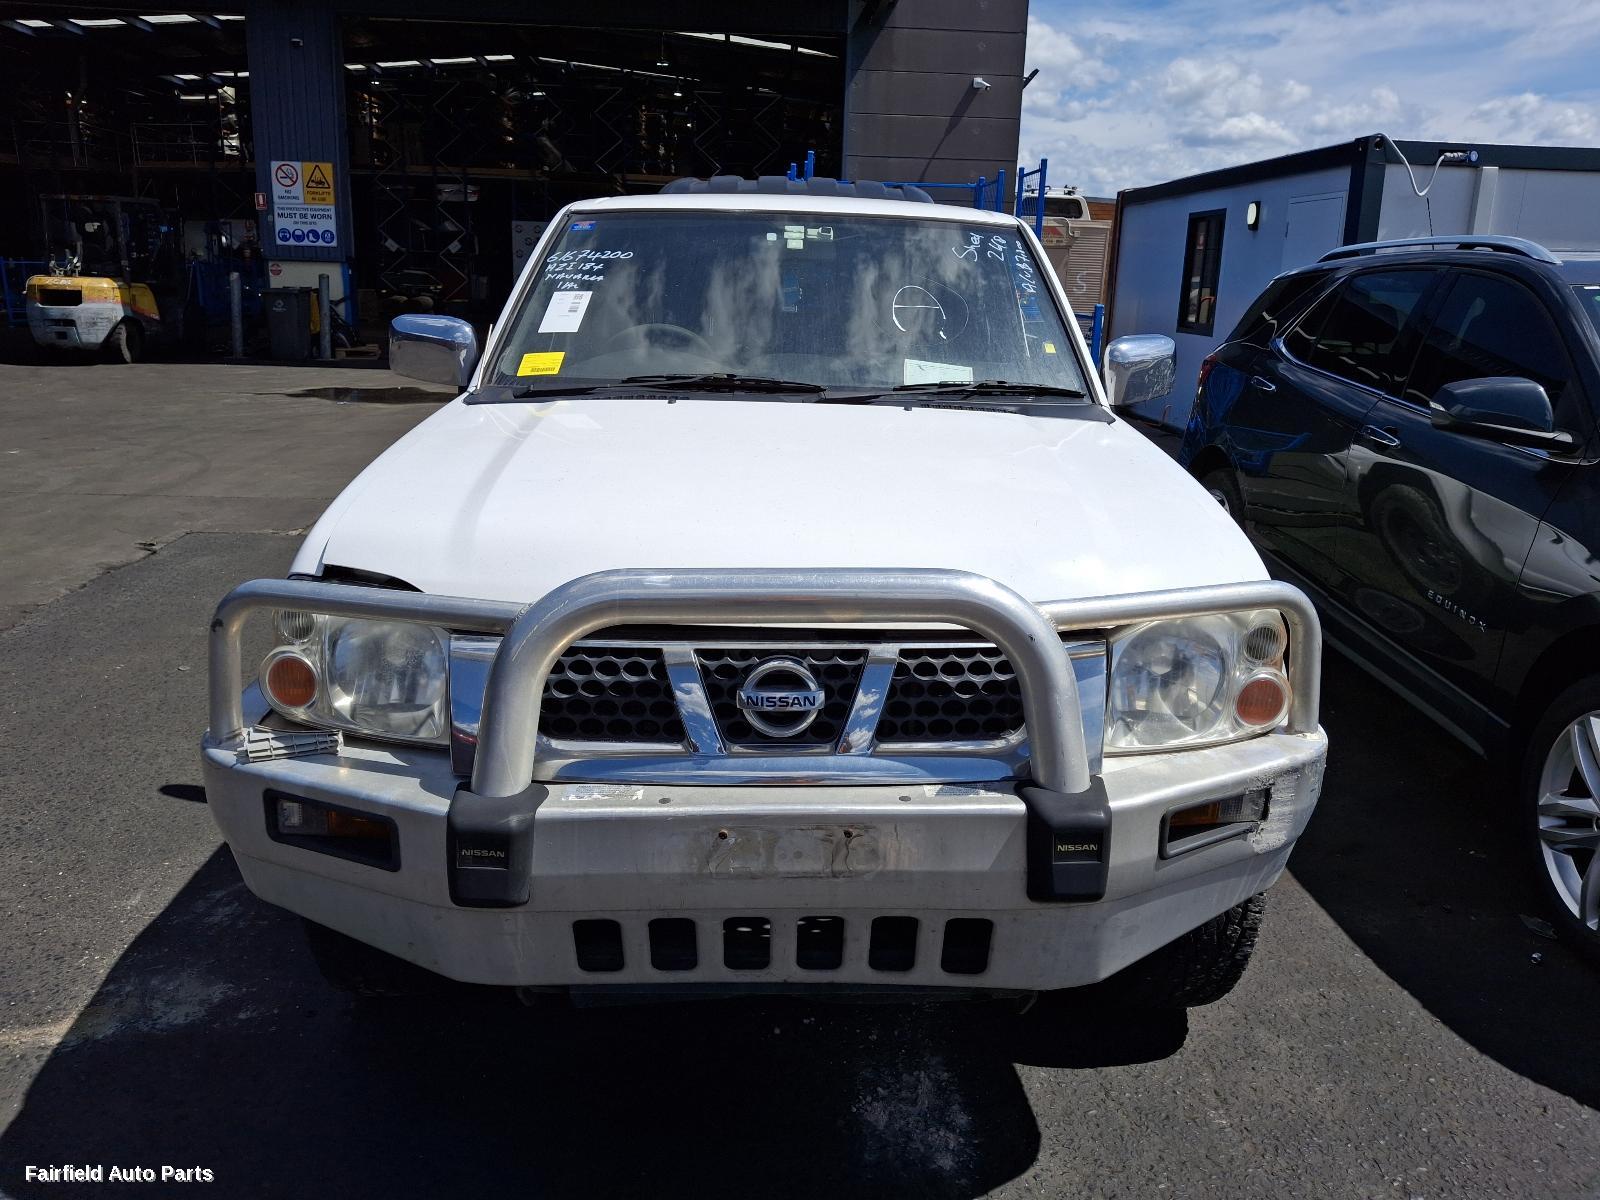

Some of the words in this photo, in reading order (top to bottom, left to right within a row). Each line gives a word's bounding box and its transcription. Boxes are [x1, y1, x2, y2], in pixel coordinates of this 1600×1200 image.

[1427, 589, 1487, 633] EQUINOX
[746, 695, 816, 708] NISSAN
[461, 848, 505, 858] NISSAN
[1057, 843, 1098, 852] NISSAN
